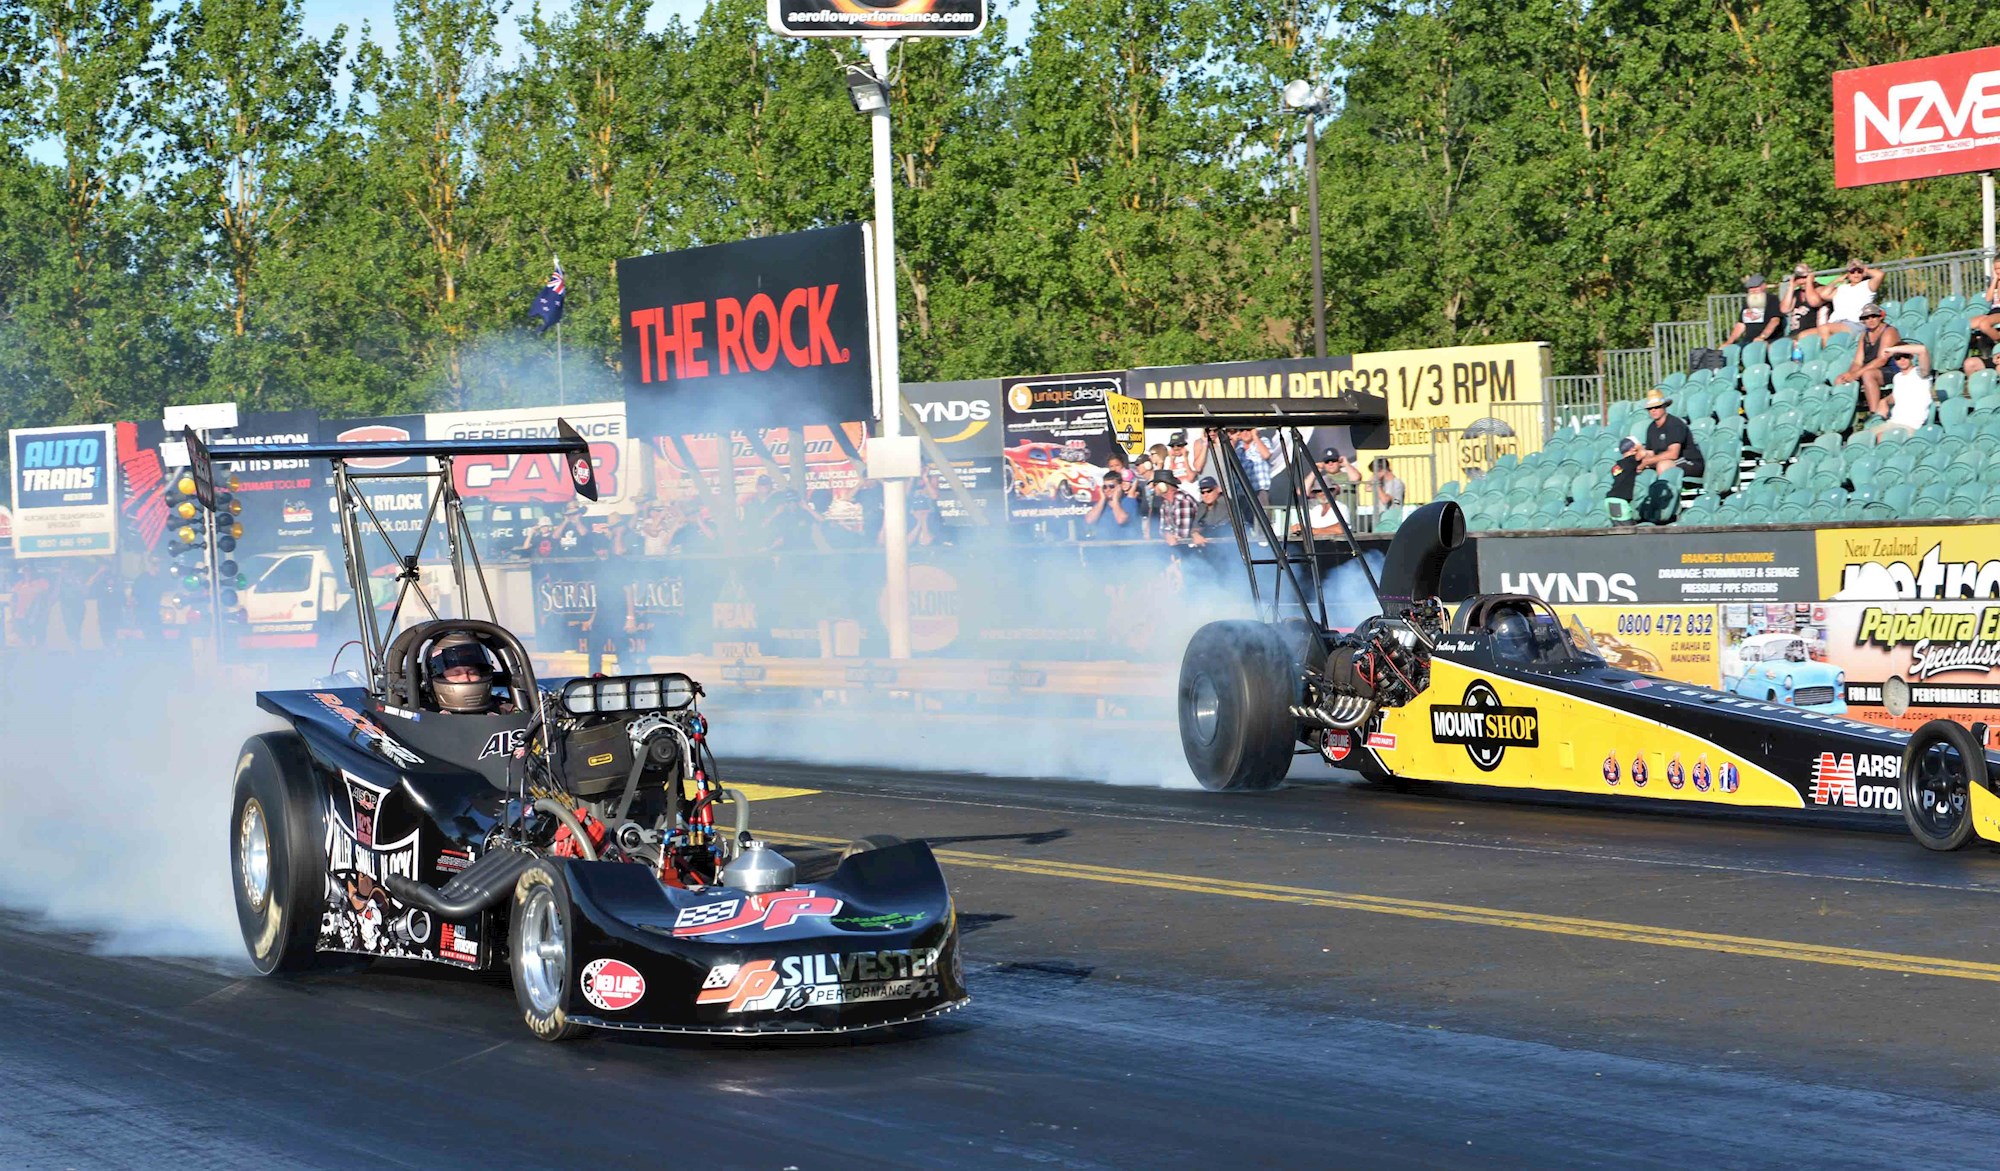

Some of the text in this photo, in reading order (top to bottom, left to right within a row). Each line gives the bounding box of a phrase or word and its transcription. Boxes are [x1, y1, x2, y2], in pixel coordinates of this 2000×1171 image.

[788, 10, 974, 24] aeroflowperformance.com
[631, 301, 709, 383] THE
[1399, 364, 1444, 411] 1/3
[1453, 360, 1516, 403] RPM
[909, 400, 991, 423] YNDS
[454, 422, 620, 440] PERFORMNCE
[1398, 431, 1449, 446] COLLECON
[24, 438, 99, 468] AUTO
[22, 466, 96, 491] TRANS
[1681, 552, 1774, 563] BRANCHES NATIONWIDE
[1845, 537, 1918, 557] New Zealand
[1501, 572, 1638, 601] HYNDS
[1681, 582, 1778, 593] PRESSURE PIPE SYSTEMS
[1618, 613, 1713, 635] 0800 472 832
[1859, 607, 1976, 647] Papakura
[1848, 687, 1866, 701] FOR
[1867, 687, 1883, 701] ALL
[1912, 688, 1979, 703] PERFORMANCE
[1434, 711, 1536, 741] MOUNT SHOP
[478, 728, 527, 760] ALS
[782, 947, 940, 986] SILVESTER
[615, 975, 641, 993] LINE
[817, 984, 911, 1001] PERFORMANCE
